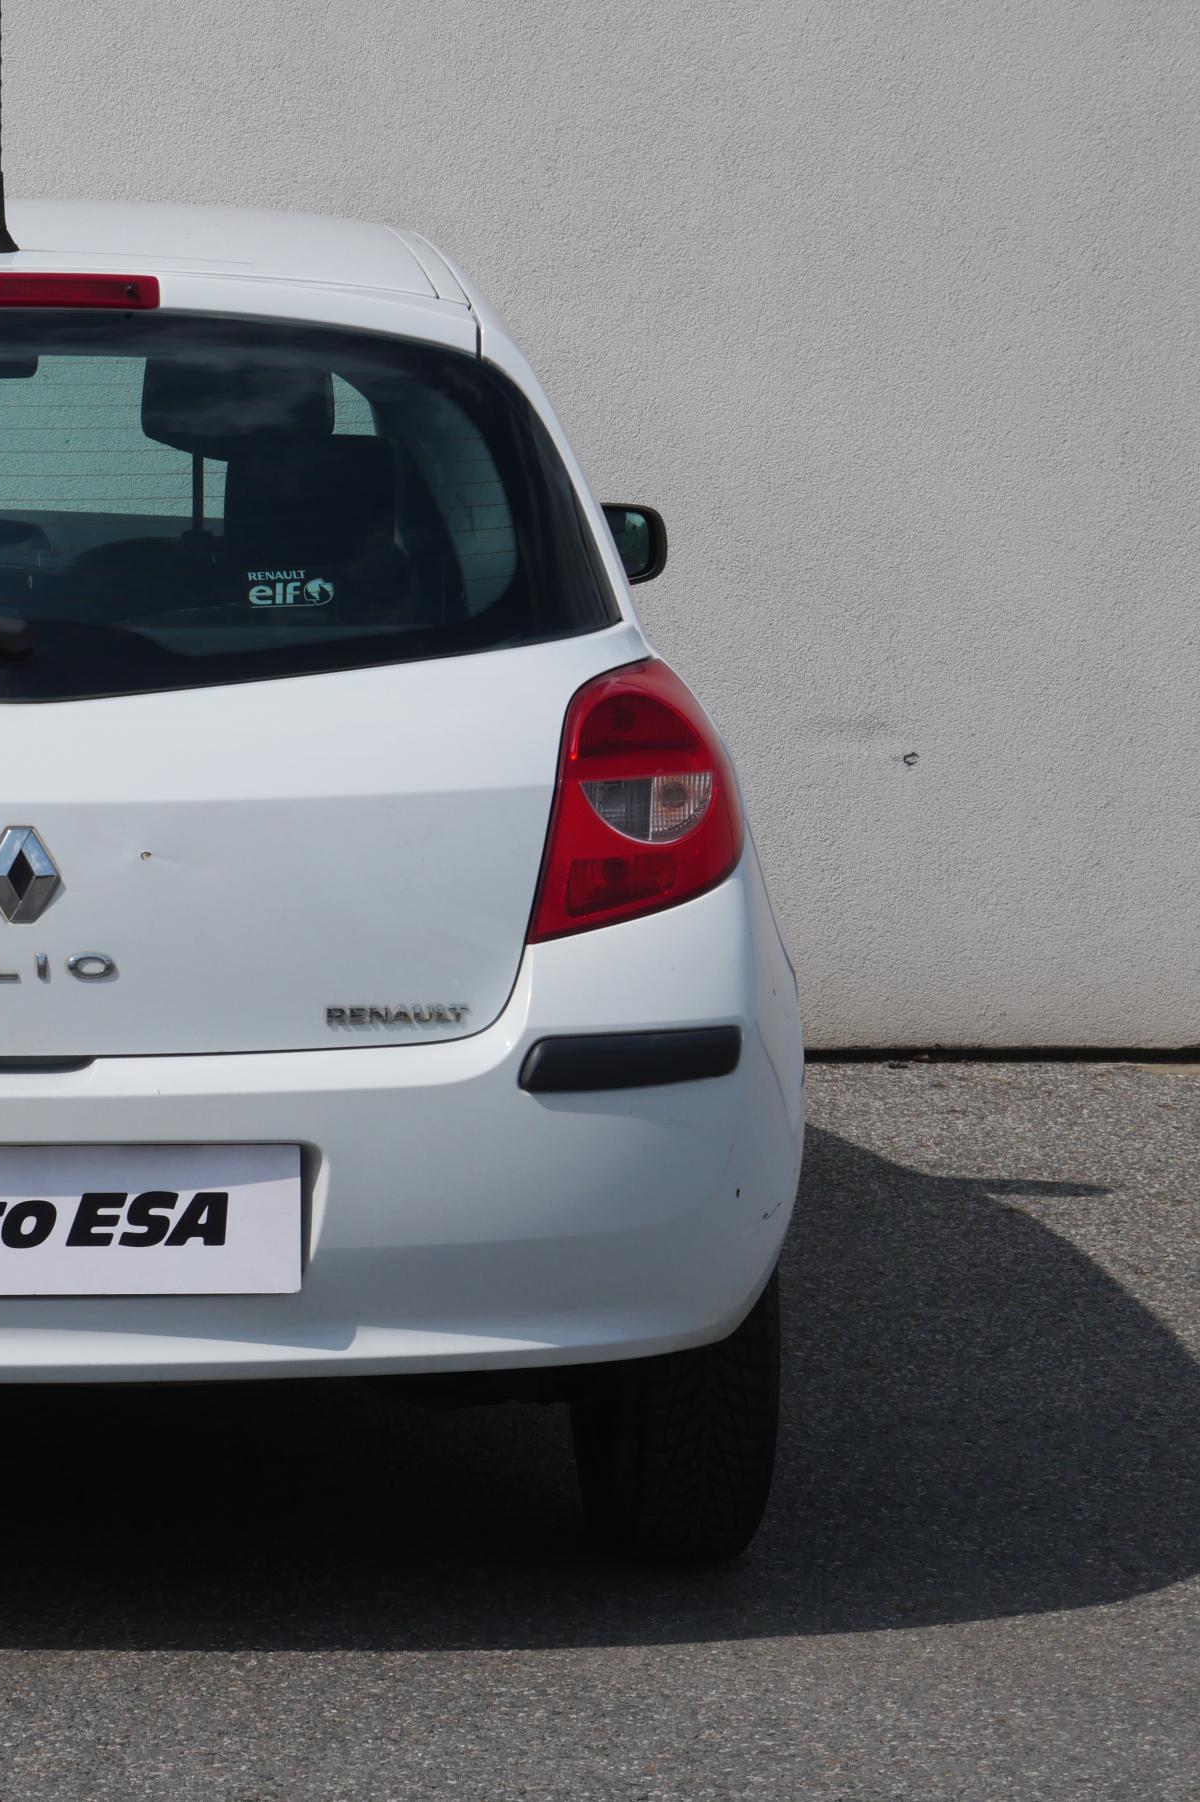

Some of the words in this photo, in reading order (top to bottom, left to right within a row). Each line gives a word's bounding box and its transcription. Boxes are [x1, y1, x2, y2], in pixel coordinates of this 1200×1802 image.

[247, 570, 306, 581] RENAULT
[248, 581, 301, 605] elf
[325, 1003, 472, 1031] RENAULT
[65, 1191, 230, 1248] ESA
